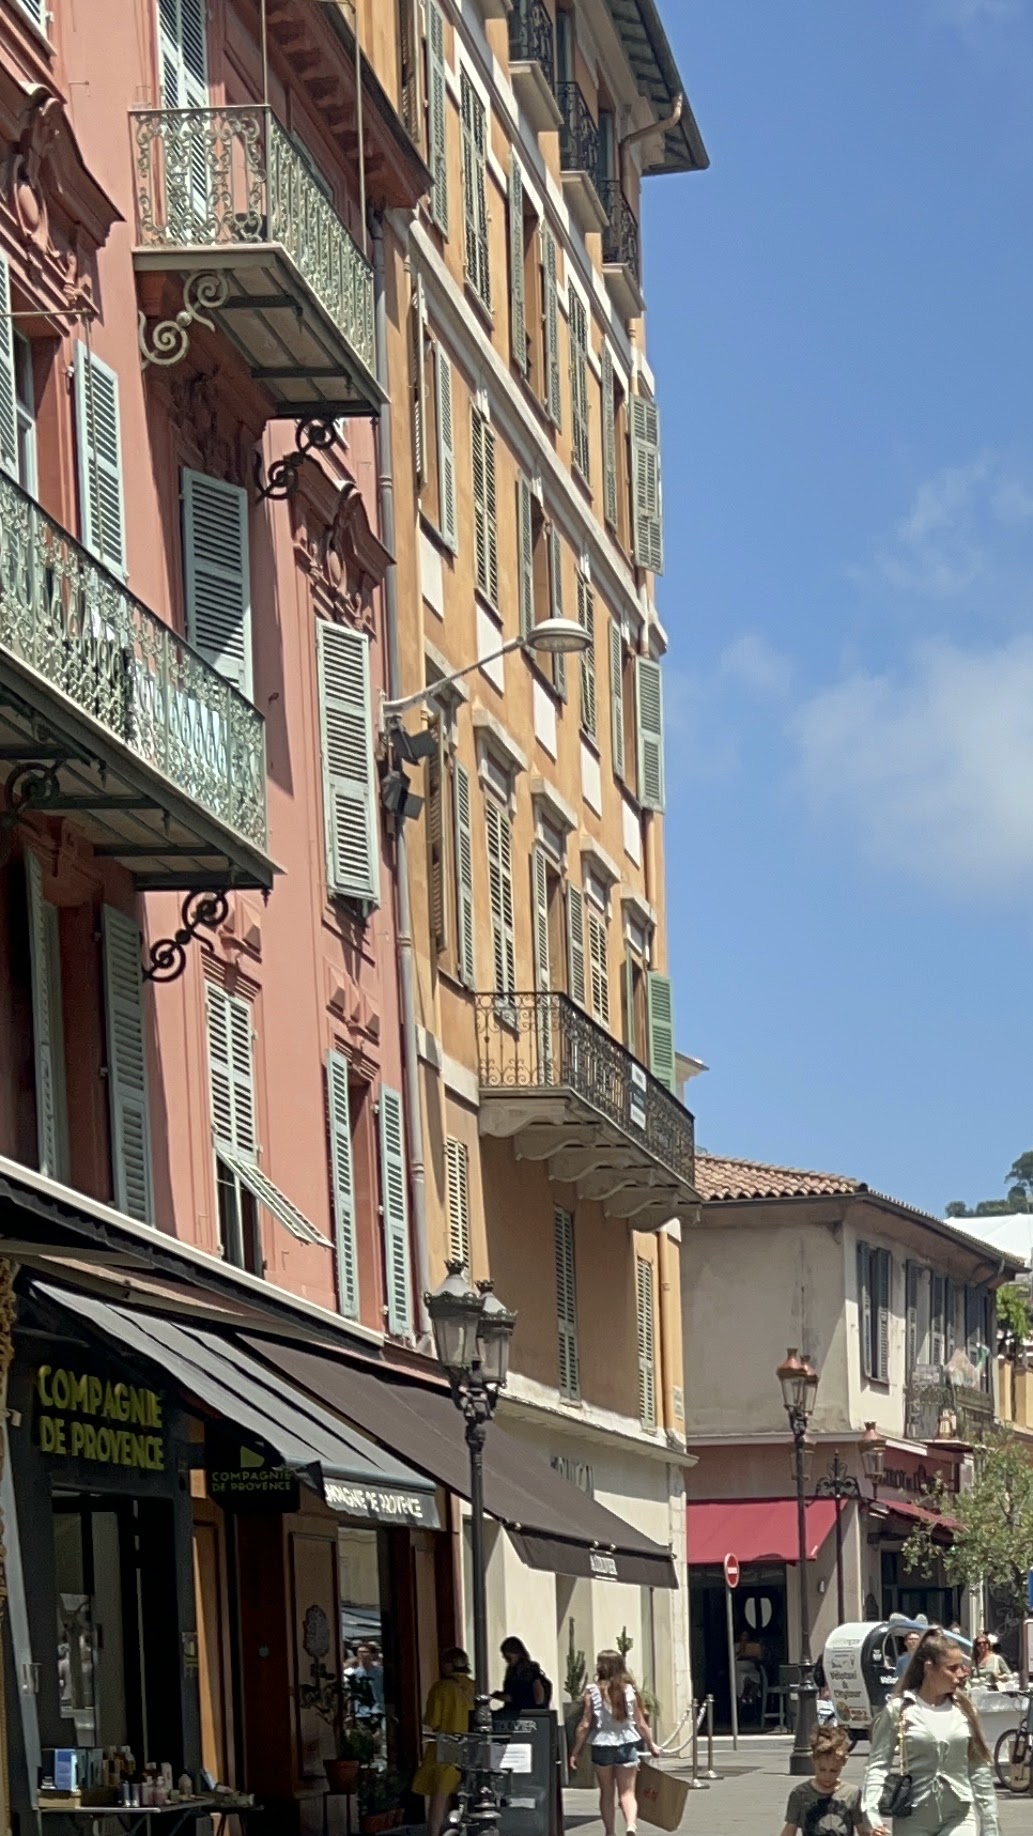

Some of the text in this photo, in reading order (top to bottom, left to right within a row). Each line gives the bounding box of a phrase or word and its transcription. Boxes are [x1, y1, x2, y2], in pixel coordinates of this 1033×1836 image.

[38, 1364, 162, 1428] COMPAGNIE
[39, 1415, 165, 1471] DE PROVENCE
[211, 1470, 292, 1482] COMPAGNIE
[211, 1481, 291, 1492] DE PROVENCE
